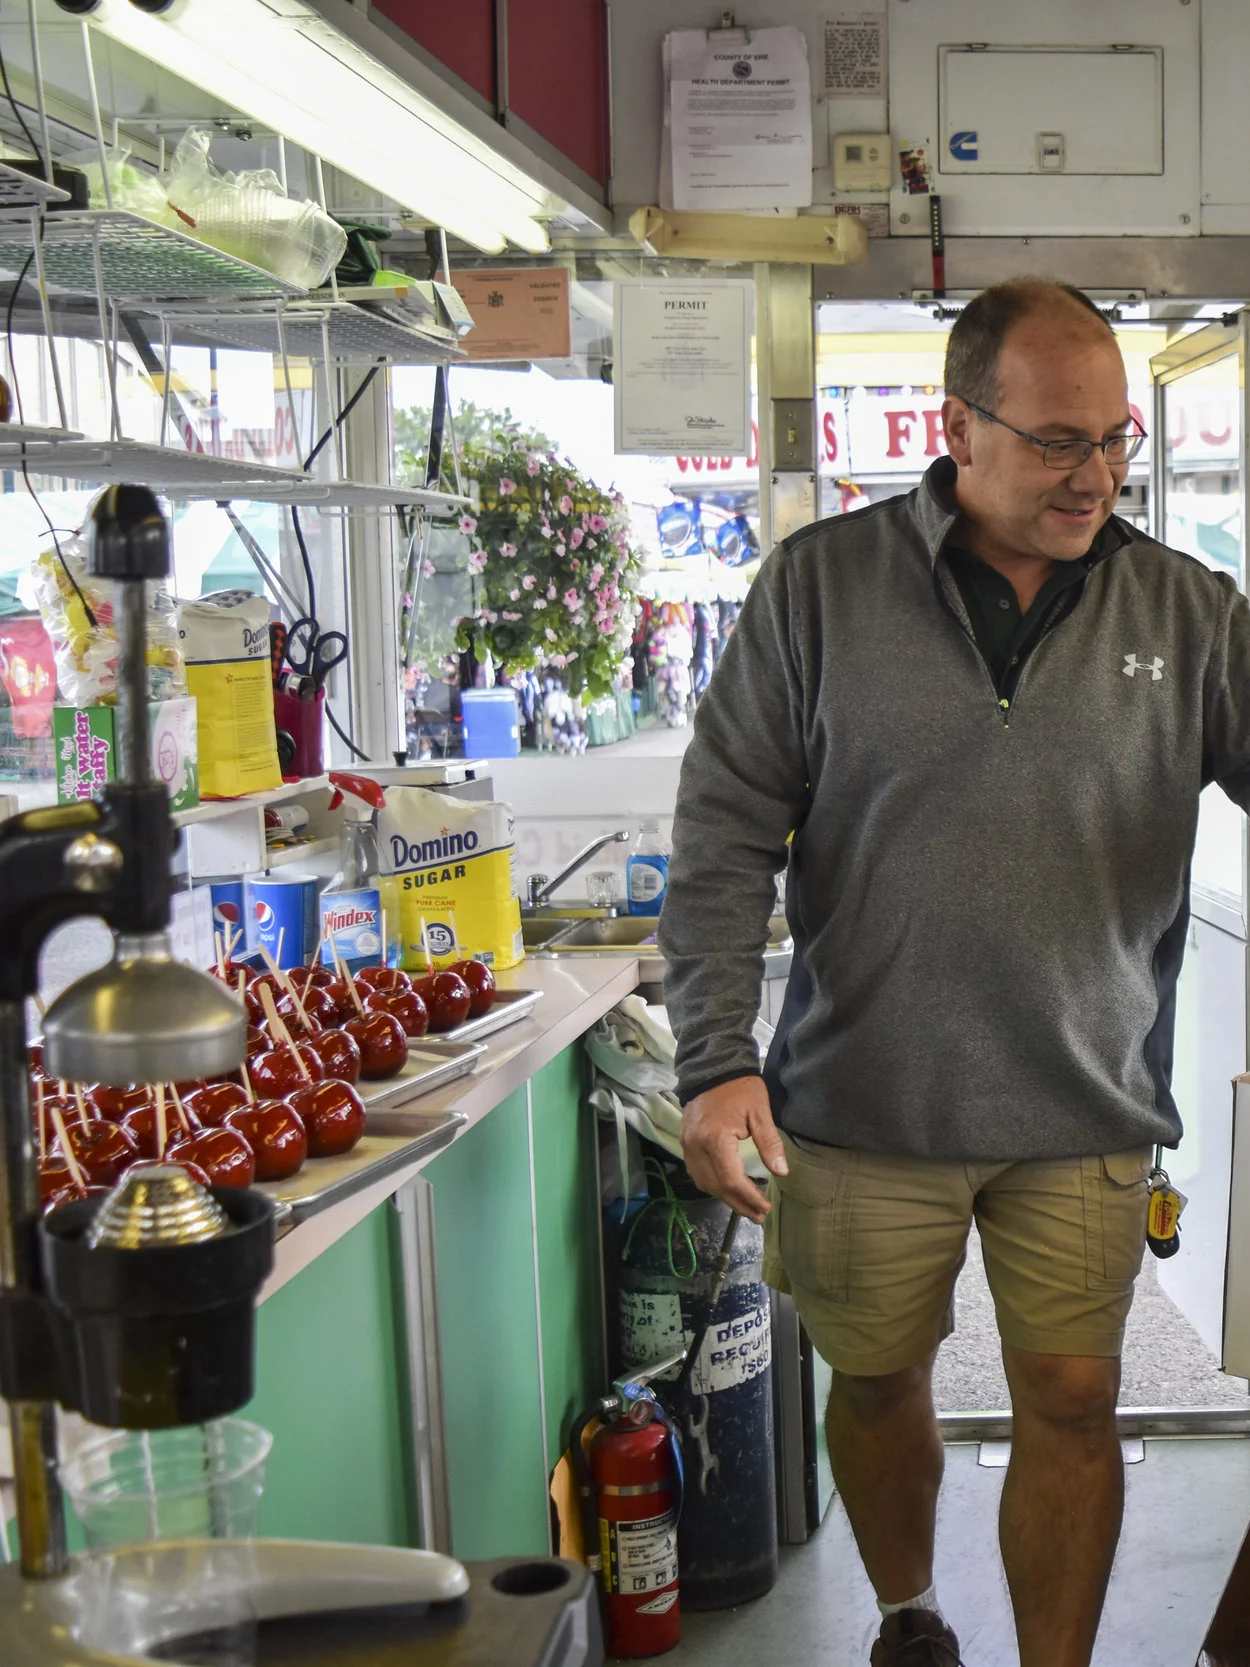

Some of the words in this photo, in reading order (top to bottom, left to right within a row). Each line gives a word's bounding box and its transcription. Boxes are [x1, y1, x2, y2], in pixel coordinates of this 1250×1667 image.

[767, 79, 790, 87] PERMIT
[664, 301, 707, 310] PERMIT
[74, 711, 90, 778] water
[90, 735, 110, 790] taffy
[390, 829, 478, 868] Domino
[403, 865, 466, 890] SUGAR
[323, 908, 377, 940] Windex
[428, 930, 447, 941] 15
